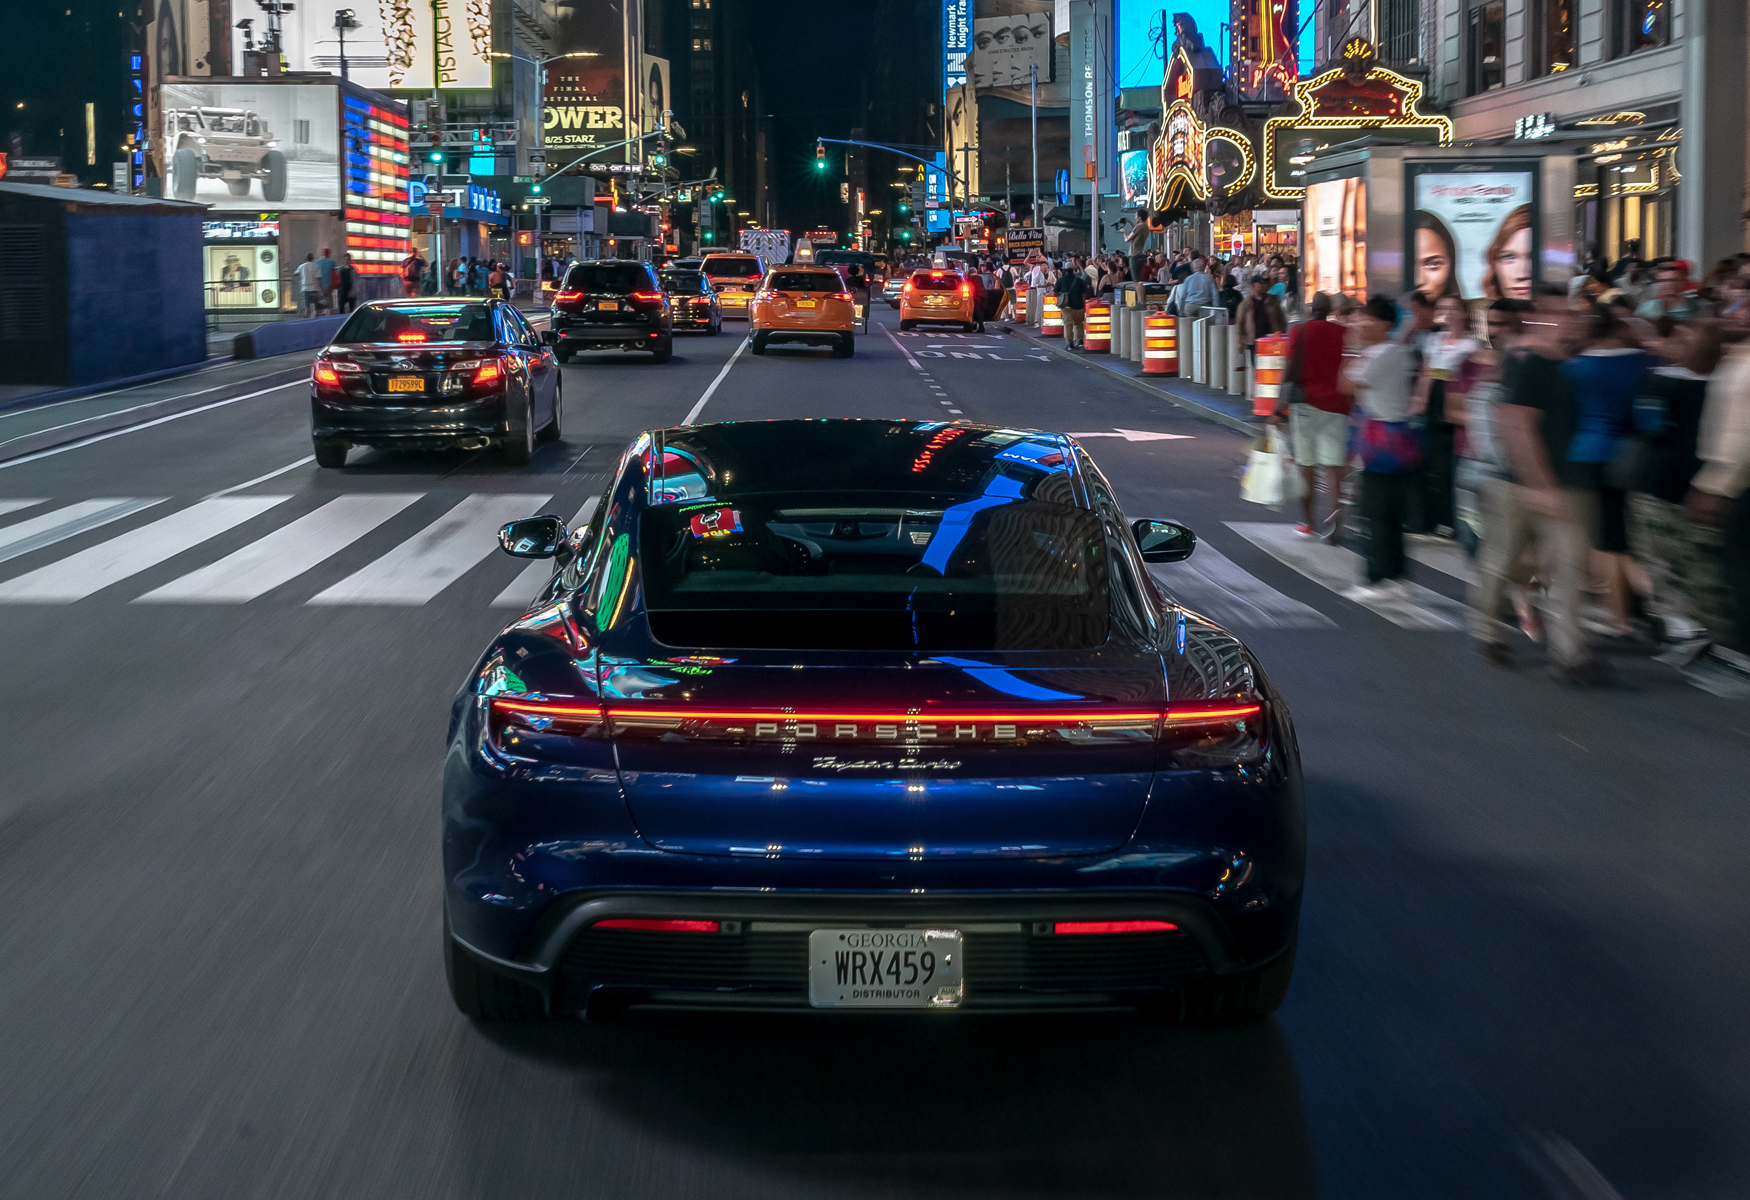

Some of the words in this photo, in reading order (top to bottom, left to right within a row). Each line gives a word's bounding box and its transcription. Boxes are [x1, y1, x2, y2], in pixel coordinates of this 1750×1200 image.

[947, 4, 956, 48] Newmark
[957, 15, 969, 48] Knight
[1085, 81, 1093, 137] THOMSON
[545, 136, 563, 144] 8/25
[564, 135, 595, 143] STARZ
[1009, 230, 1027, 241] Bella
[1028, 230, 1043, 240] Vita
[897, 332, 1004, 340] ONLY
[914, 350, 1051, 362] ONLY
[755, 722, 1017, 739] PORSCHE
[812, 756, 895, 772] Taycan
[897, 758, 962, 770] Turbo
[847, 933, 928, 948] GEORGIA
[835, 950, 936, 986] WRX459
[852, 989, 920, 999] DISTRIBUTOR
